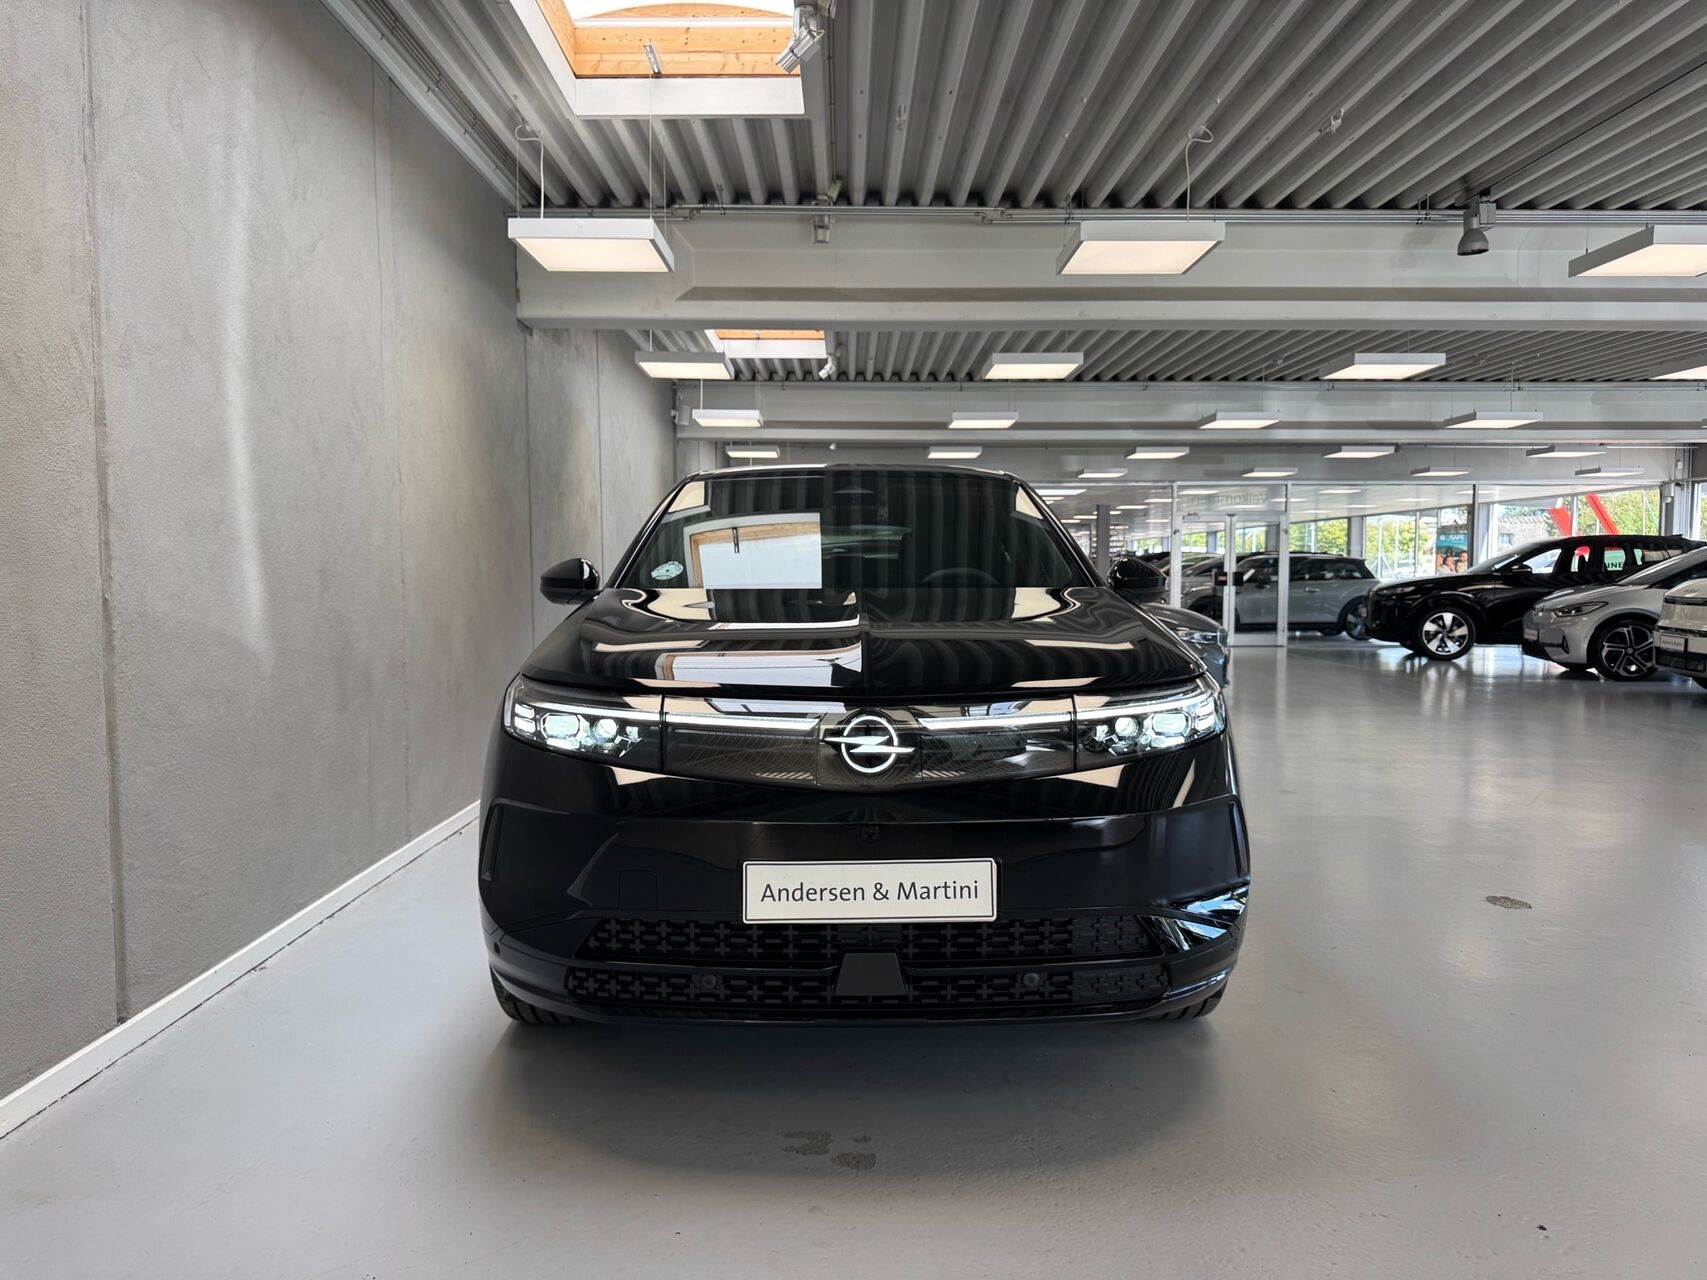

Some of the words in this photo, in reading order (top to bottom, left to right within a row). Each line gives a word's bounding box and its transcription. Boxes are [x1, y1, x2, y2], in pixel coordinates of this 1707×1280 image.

[761, 882, 865, 902] Andersen
[872, 882, 890, 901] &
[896, 880, 979, 901] Martini
